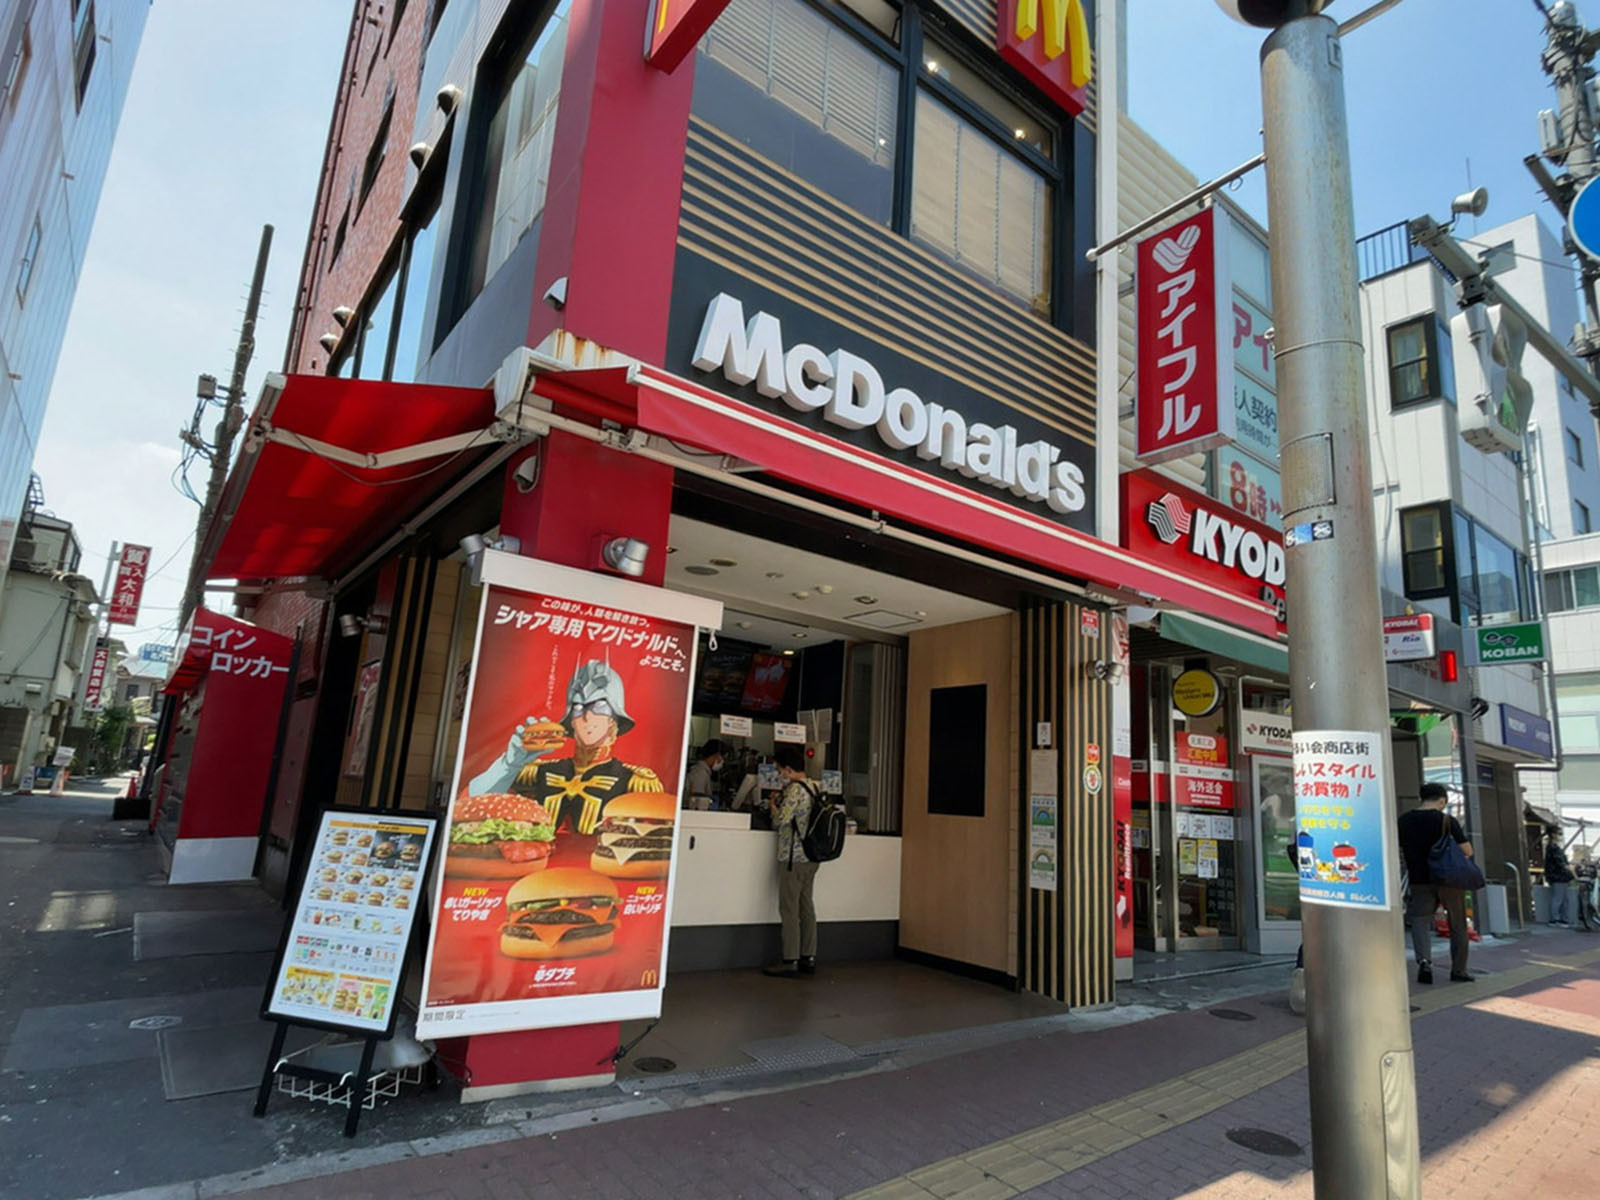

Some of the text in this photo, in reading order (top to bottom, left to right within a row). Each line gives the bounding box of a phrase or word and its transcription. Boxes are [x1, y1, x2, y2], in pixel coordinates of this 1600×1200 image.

[1157, 269, 1202, 440] アイフル
[691, 292, 1086, 514] McDonald's
[1234, 384, 1277, 433] 人契約
[1192, 508, 1287, 587] KYOD
[191, 624, 257, 651] コイン
[210, 651, 291, 679] ロッカー
[1482, 646, 1539, 659] KOBAN
[1258, 724, 1292, 740] KYODA
[1187, 779, 1223, 795] 海外送金
[463, 887, 489, 897] NEW
[636, 886, 657, 895] NEW
